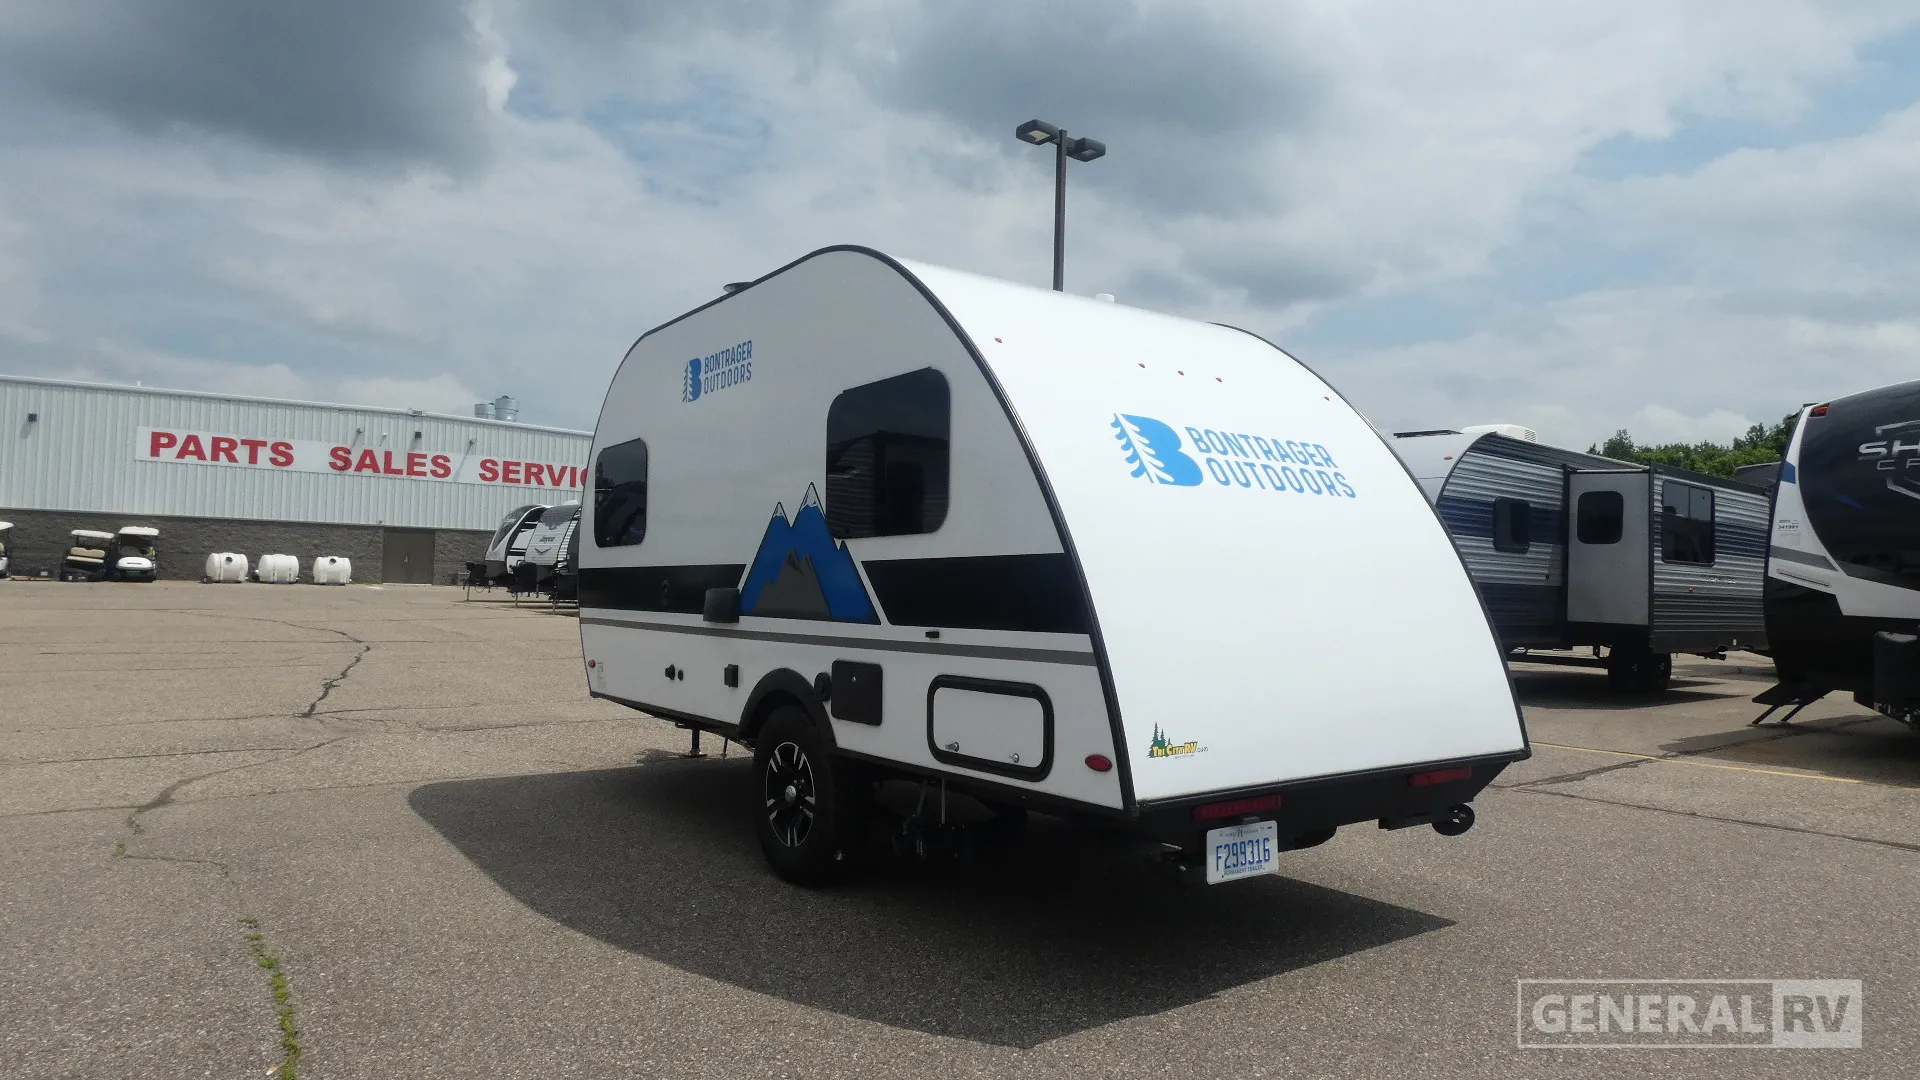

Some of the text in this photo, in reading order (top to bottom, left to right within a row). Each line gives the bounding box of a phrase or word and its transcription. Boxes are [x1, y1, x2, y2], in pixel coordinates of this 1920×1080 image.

[704, 340, 753, 375] BONTRAGER
[704, 361, 752, 395] OUTDOORS
[150, 431, 295, 467] PARTS
[328, 446, 452, 479] SALES
[1185, 426, 1339, 469] BONTRAGER
[1206, 457, 1357, 499] OUTDOORS
[1216, 837, 1271, 873] F299316
